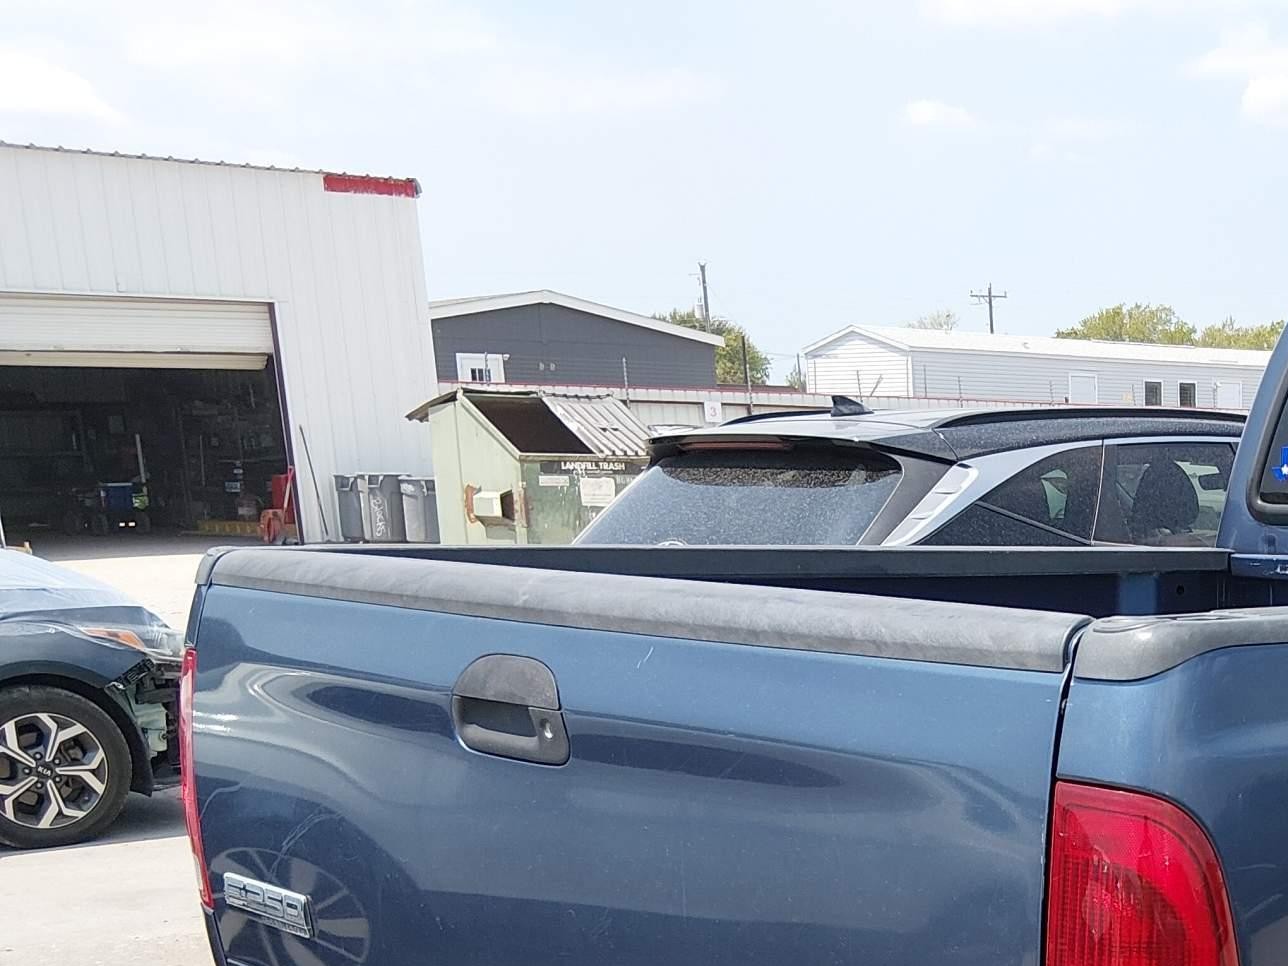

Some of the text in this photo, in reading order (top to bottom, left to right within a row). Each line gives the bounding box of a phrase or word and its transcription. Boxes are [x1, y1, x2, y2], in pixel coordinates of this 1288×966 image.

[709, 406, 718, 417] 3
[560, 461, 626, 471] LANDFILL TRASH
